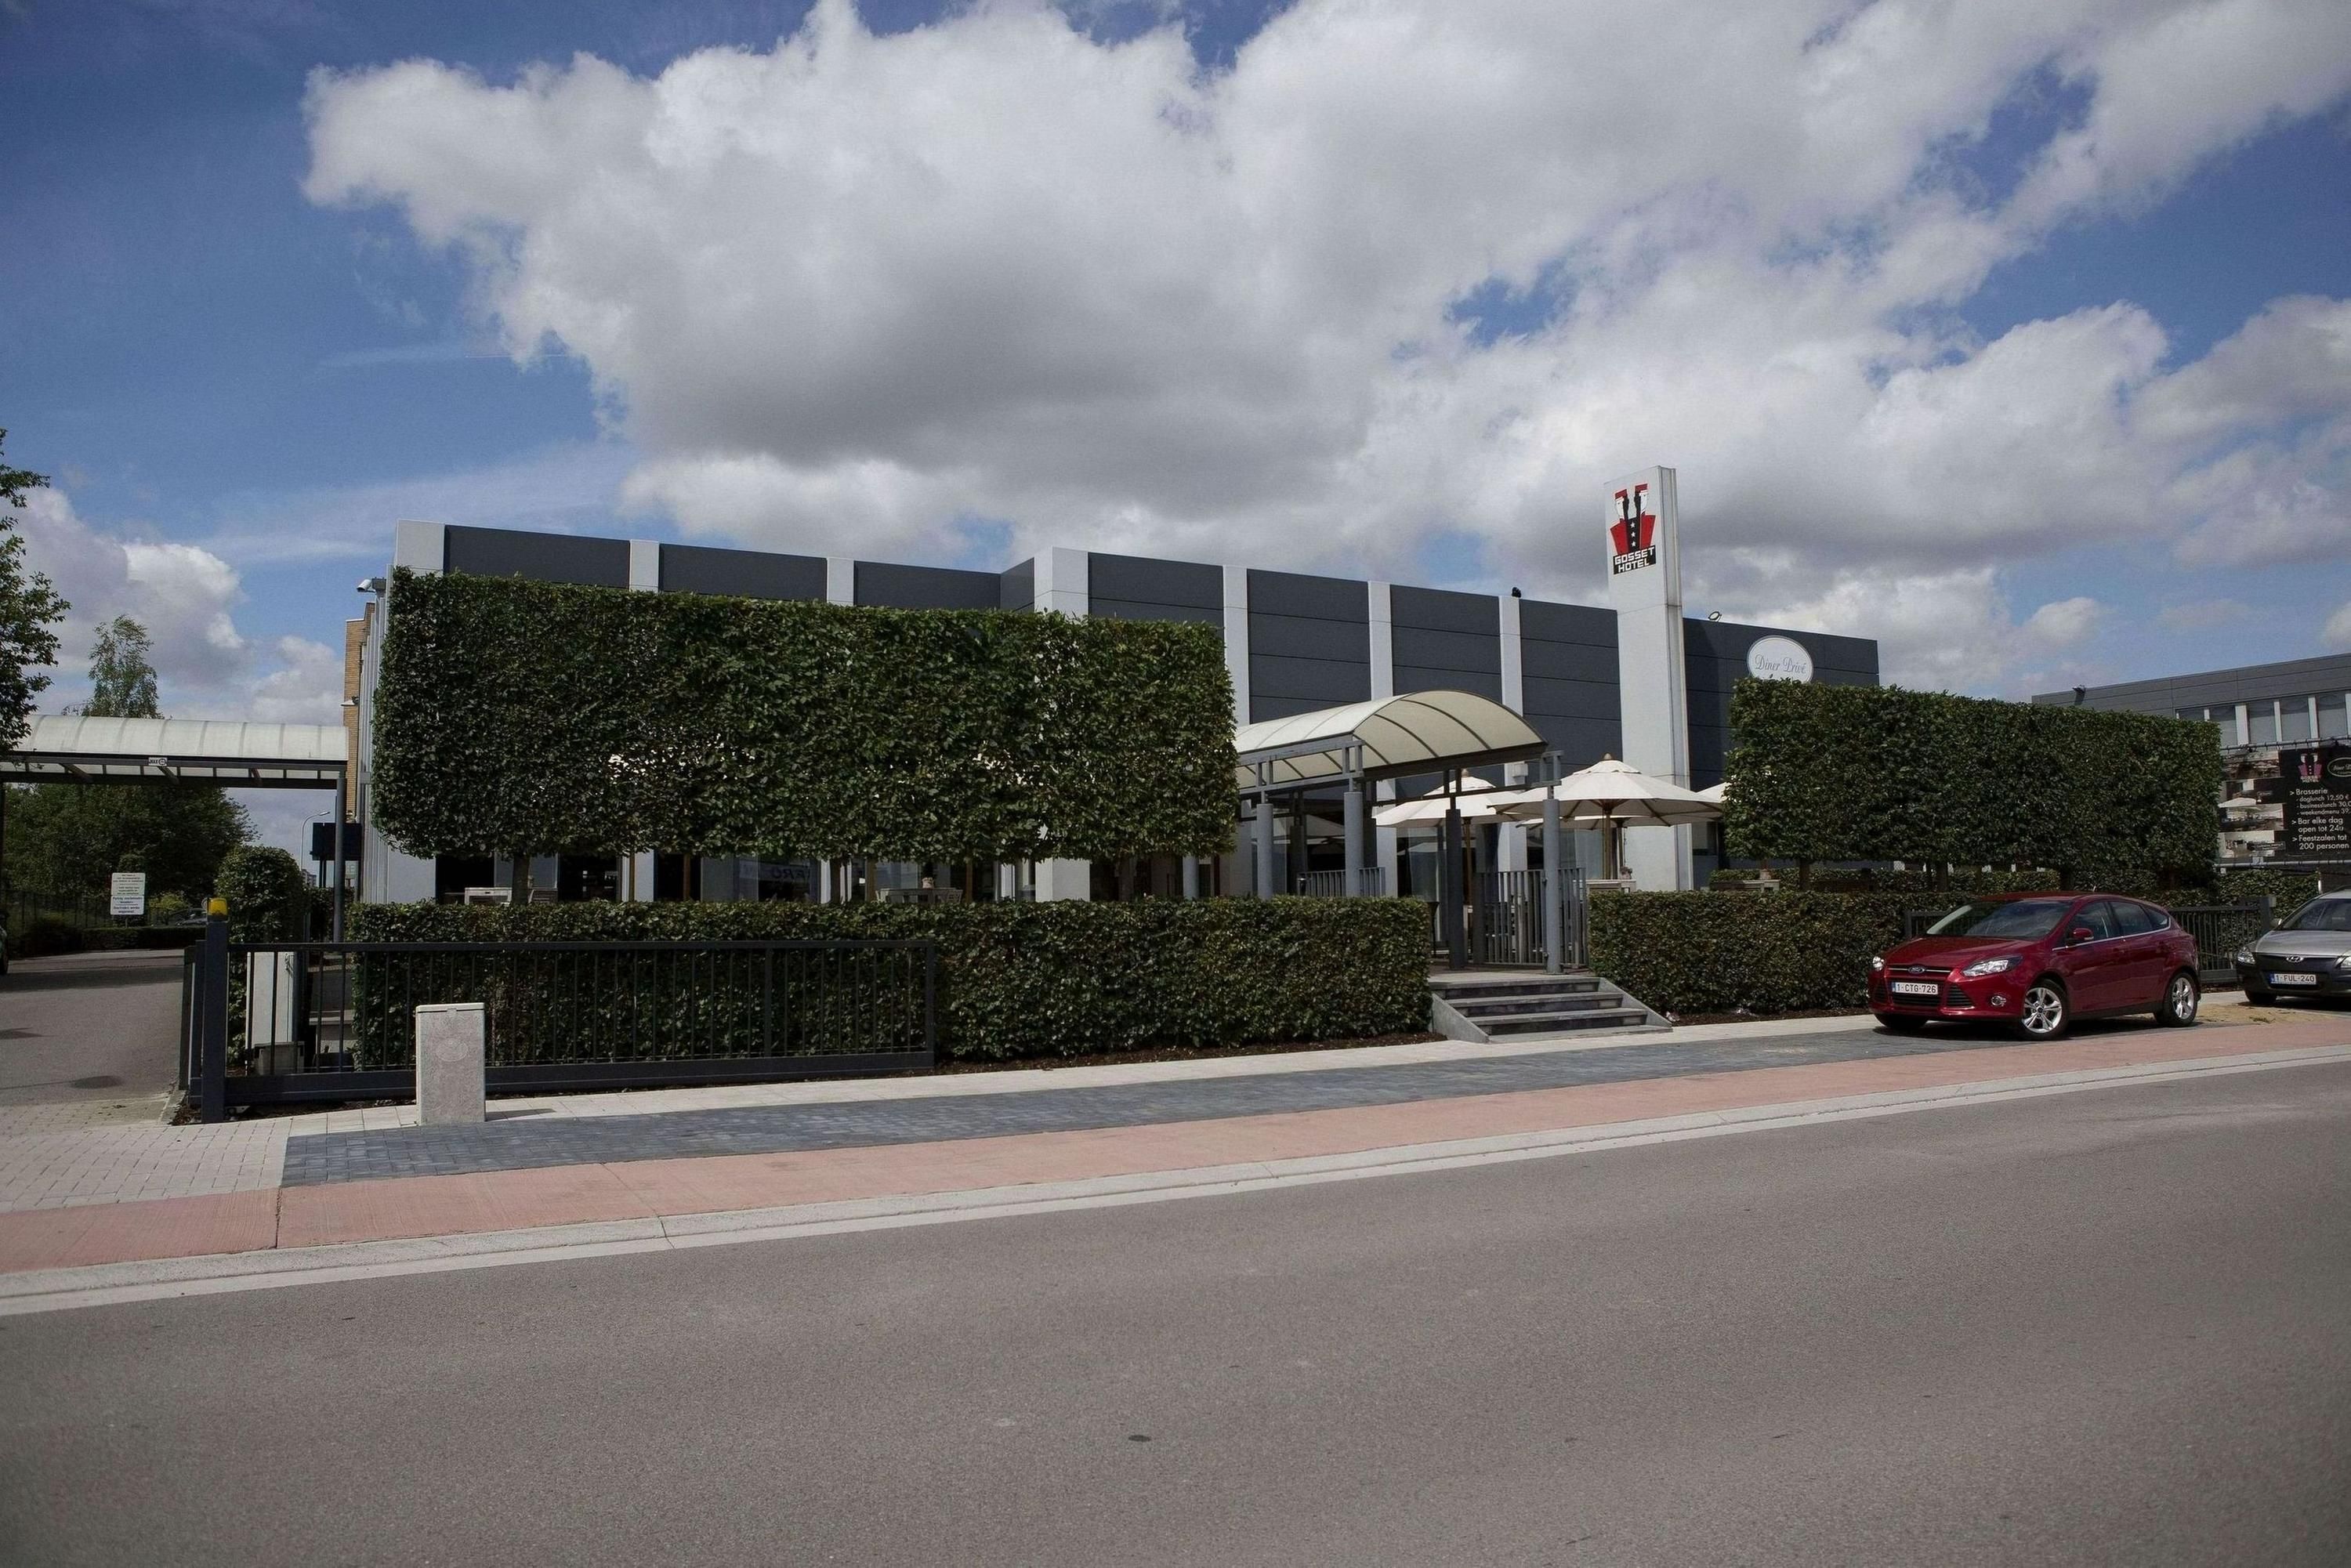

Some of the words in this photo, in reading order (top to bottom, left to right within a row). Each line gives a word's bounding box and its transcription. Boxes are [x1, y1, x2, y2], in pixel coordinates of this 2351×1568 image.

[1614, 547, 1655, 565] GOSSET
[1618, 557, 1650, 573] HOTEL
[1755, 654, 1780, 671] Diner
[2328, 817, 2343, 825] dag
[2317, 843, 2349, 852] personen
